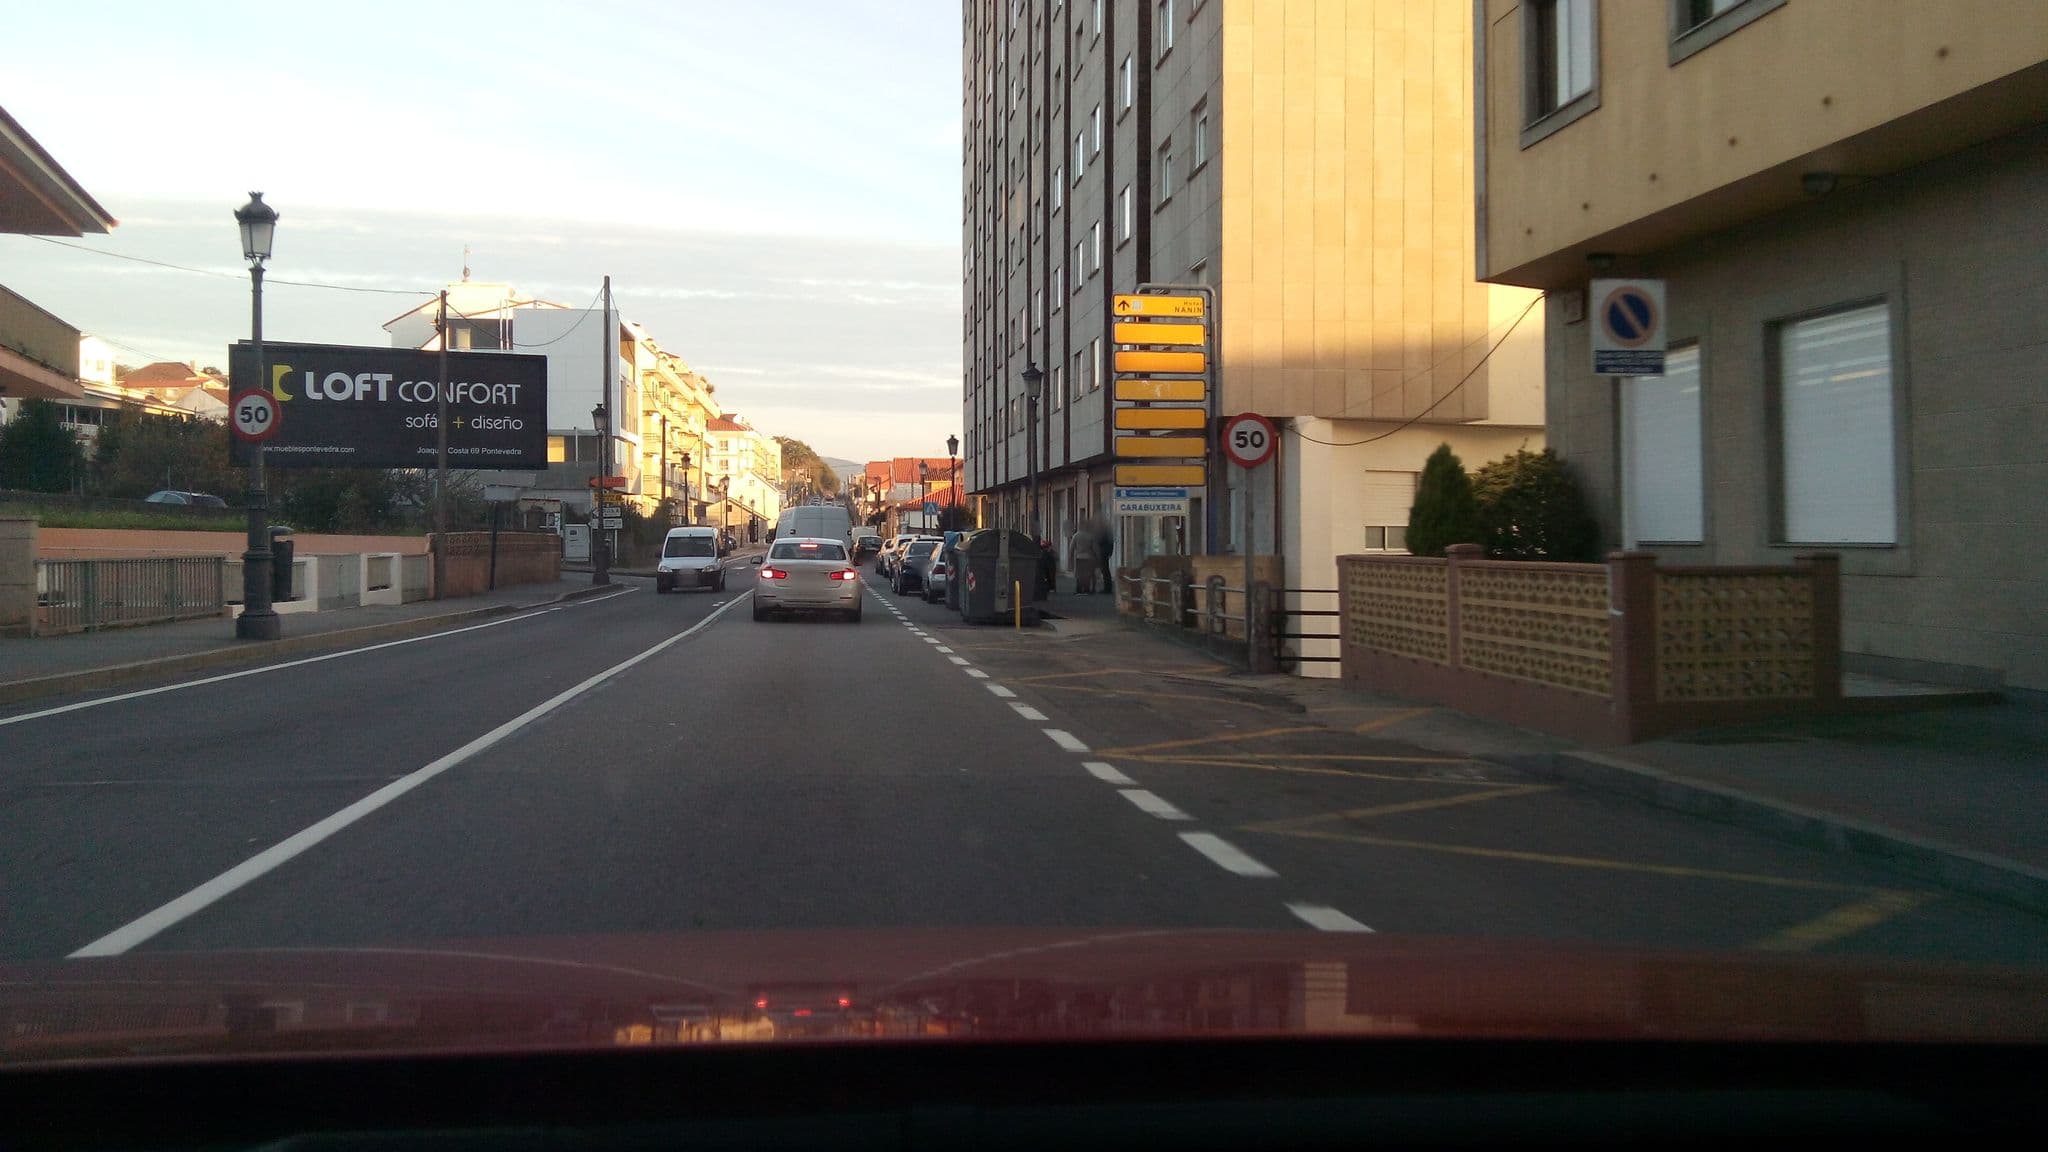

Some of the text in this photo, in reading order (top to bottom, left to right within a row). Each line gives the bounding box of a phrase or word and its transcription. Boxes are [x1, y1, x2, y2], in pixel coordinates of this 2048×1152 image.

[305, 371, 521, 405] LOFT CONFORT
[240, 406, 269, 424] 50
[405, 413, 441, 428] sofá
[471, 416, 523, 430] diseño
[1235, 430, 1265, 449] 50
[447, 446, 469, 455] Costa
[481, 447, 522, 456] Pontevedra
[1120, 503, 1183, 512] CARABUXEIRA
